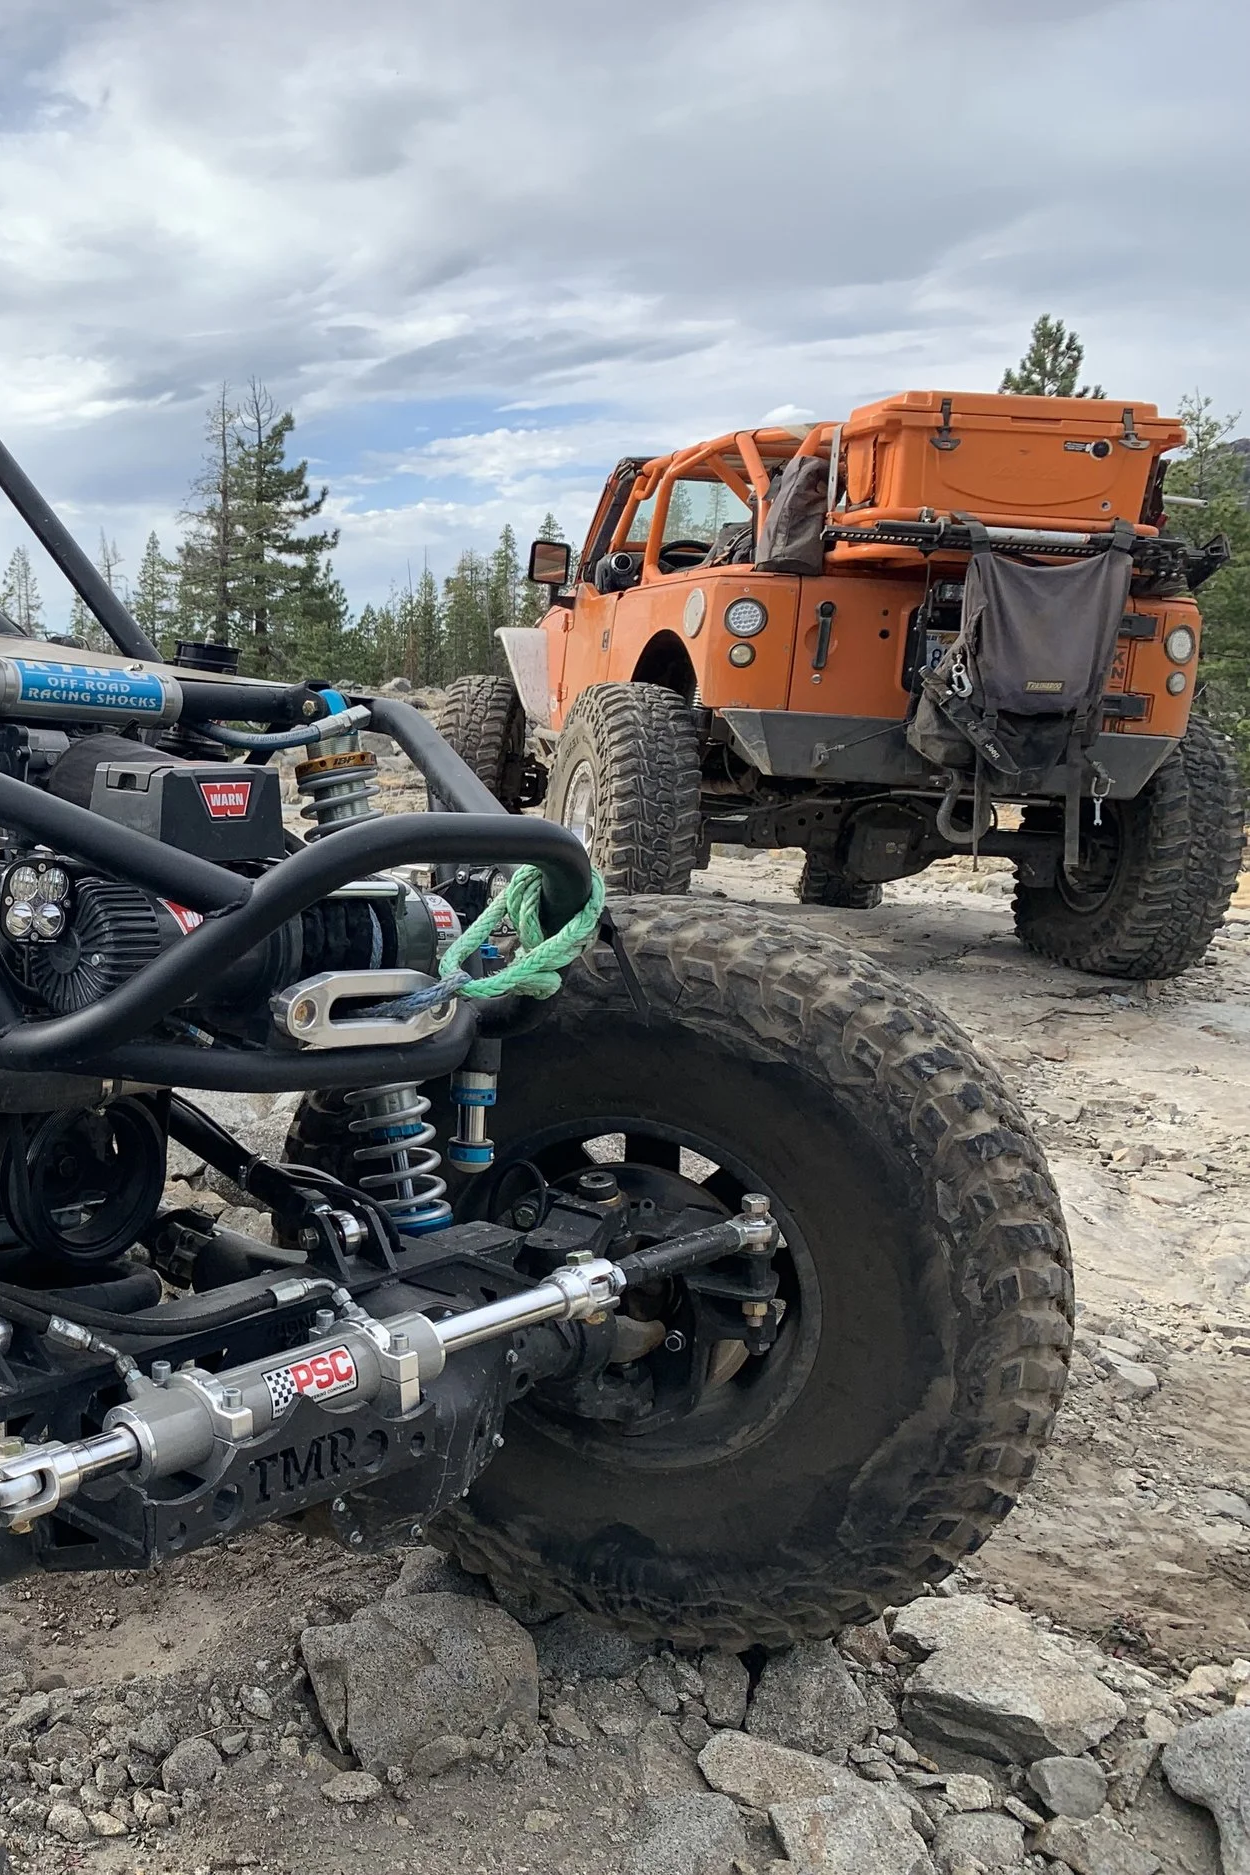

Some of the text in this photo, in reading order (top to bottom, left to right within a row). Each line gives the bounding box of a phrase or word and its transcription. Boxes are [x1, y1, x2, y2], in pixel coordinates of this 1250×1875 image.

[47, 676, 131, 694] OFF-ROAD
[28, 687, 157, 708] RACING SHOCKS
[985, 743, 1001, 760] Jeep
[210, 792, 244, 807] WARN
[290, 1350, 353, 1397] PSC
[249, 1427, 356, 1504] TMR
